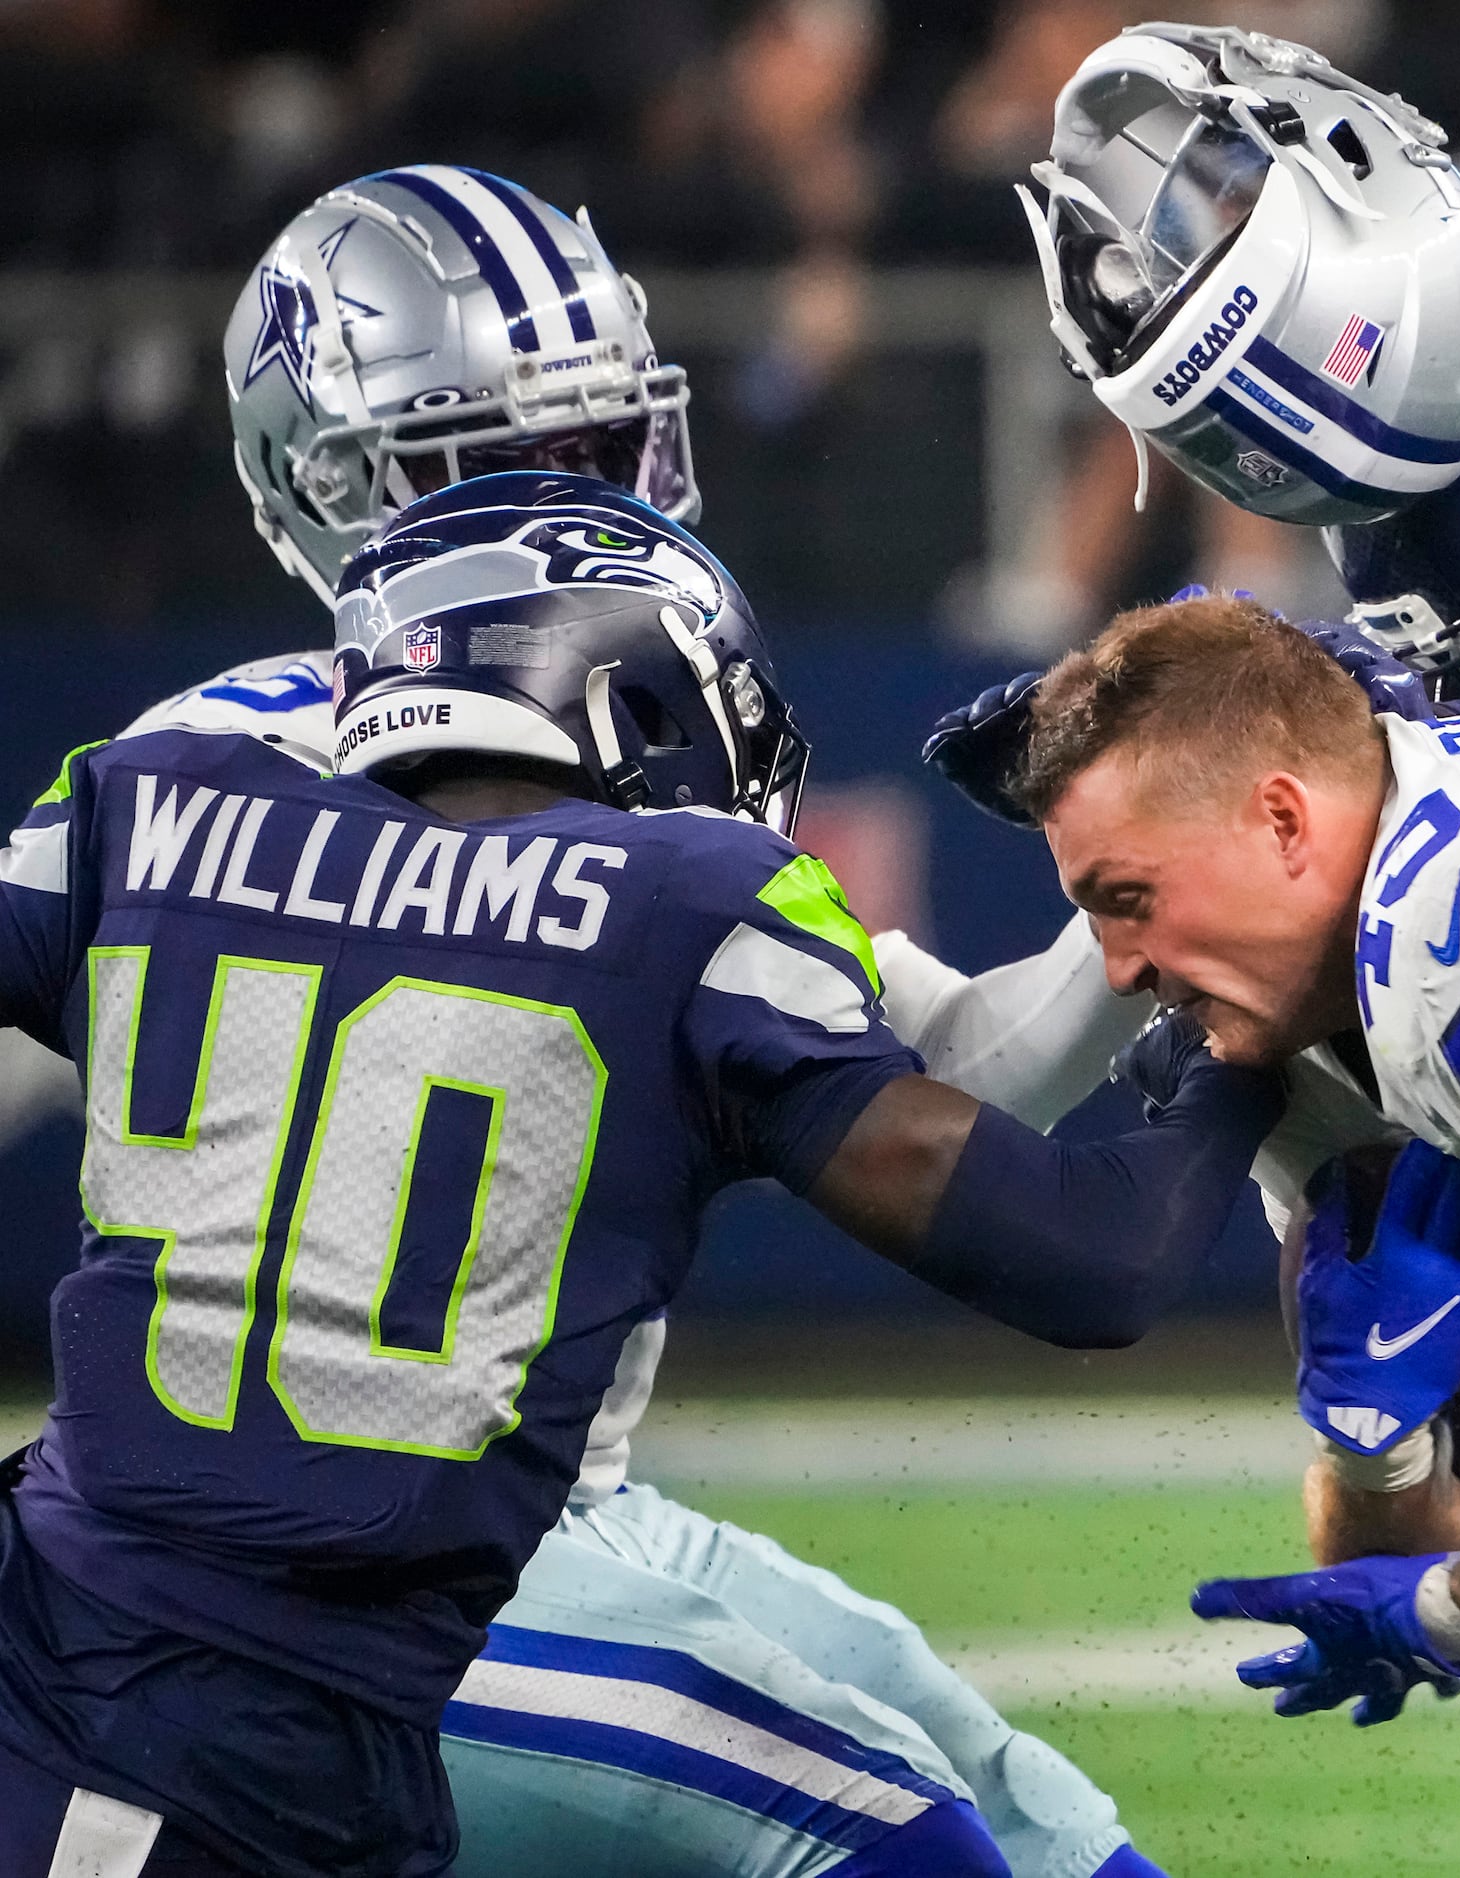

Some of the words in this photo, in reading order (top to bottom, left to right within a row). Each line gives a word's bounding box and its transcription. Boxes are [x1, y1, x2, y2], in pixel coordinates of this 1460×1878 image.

[1152, 285, 1258, 407] COWBOYS
[408, 645, 435, 663] NFL
[334, 714, 380, 774] CHOOSE
[386, 704, 451, 732] LOVE
[126, 774, 628, 952] WILLIAMS
[80, 945, 610, 1462] 40
